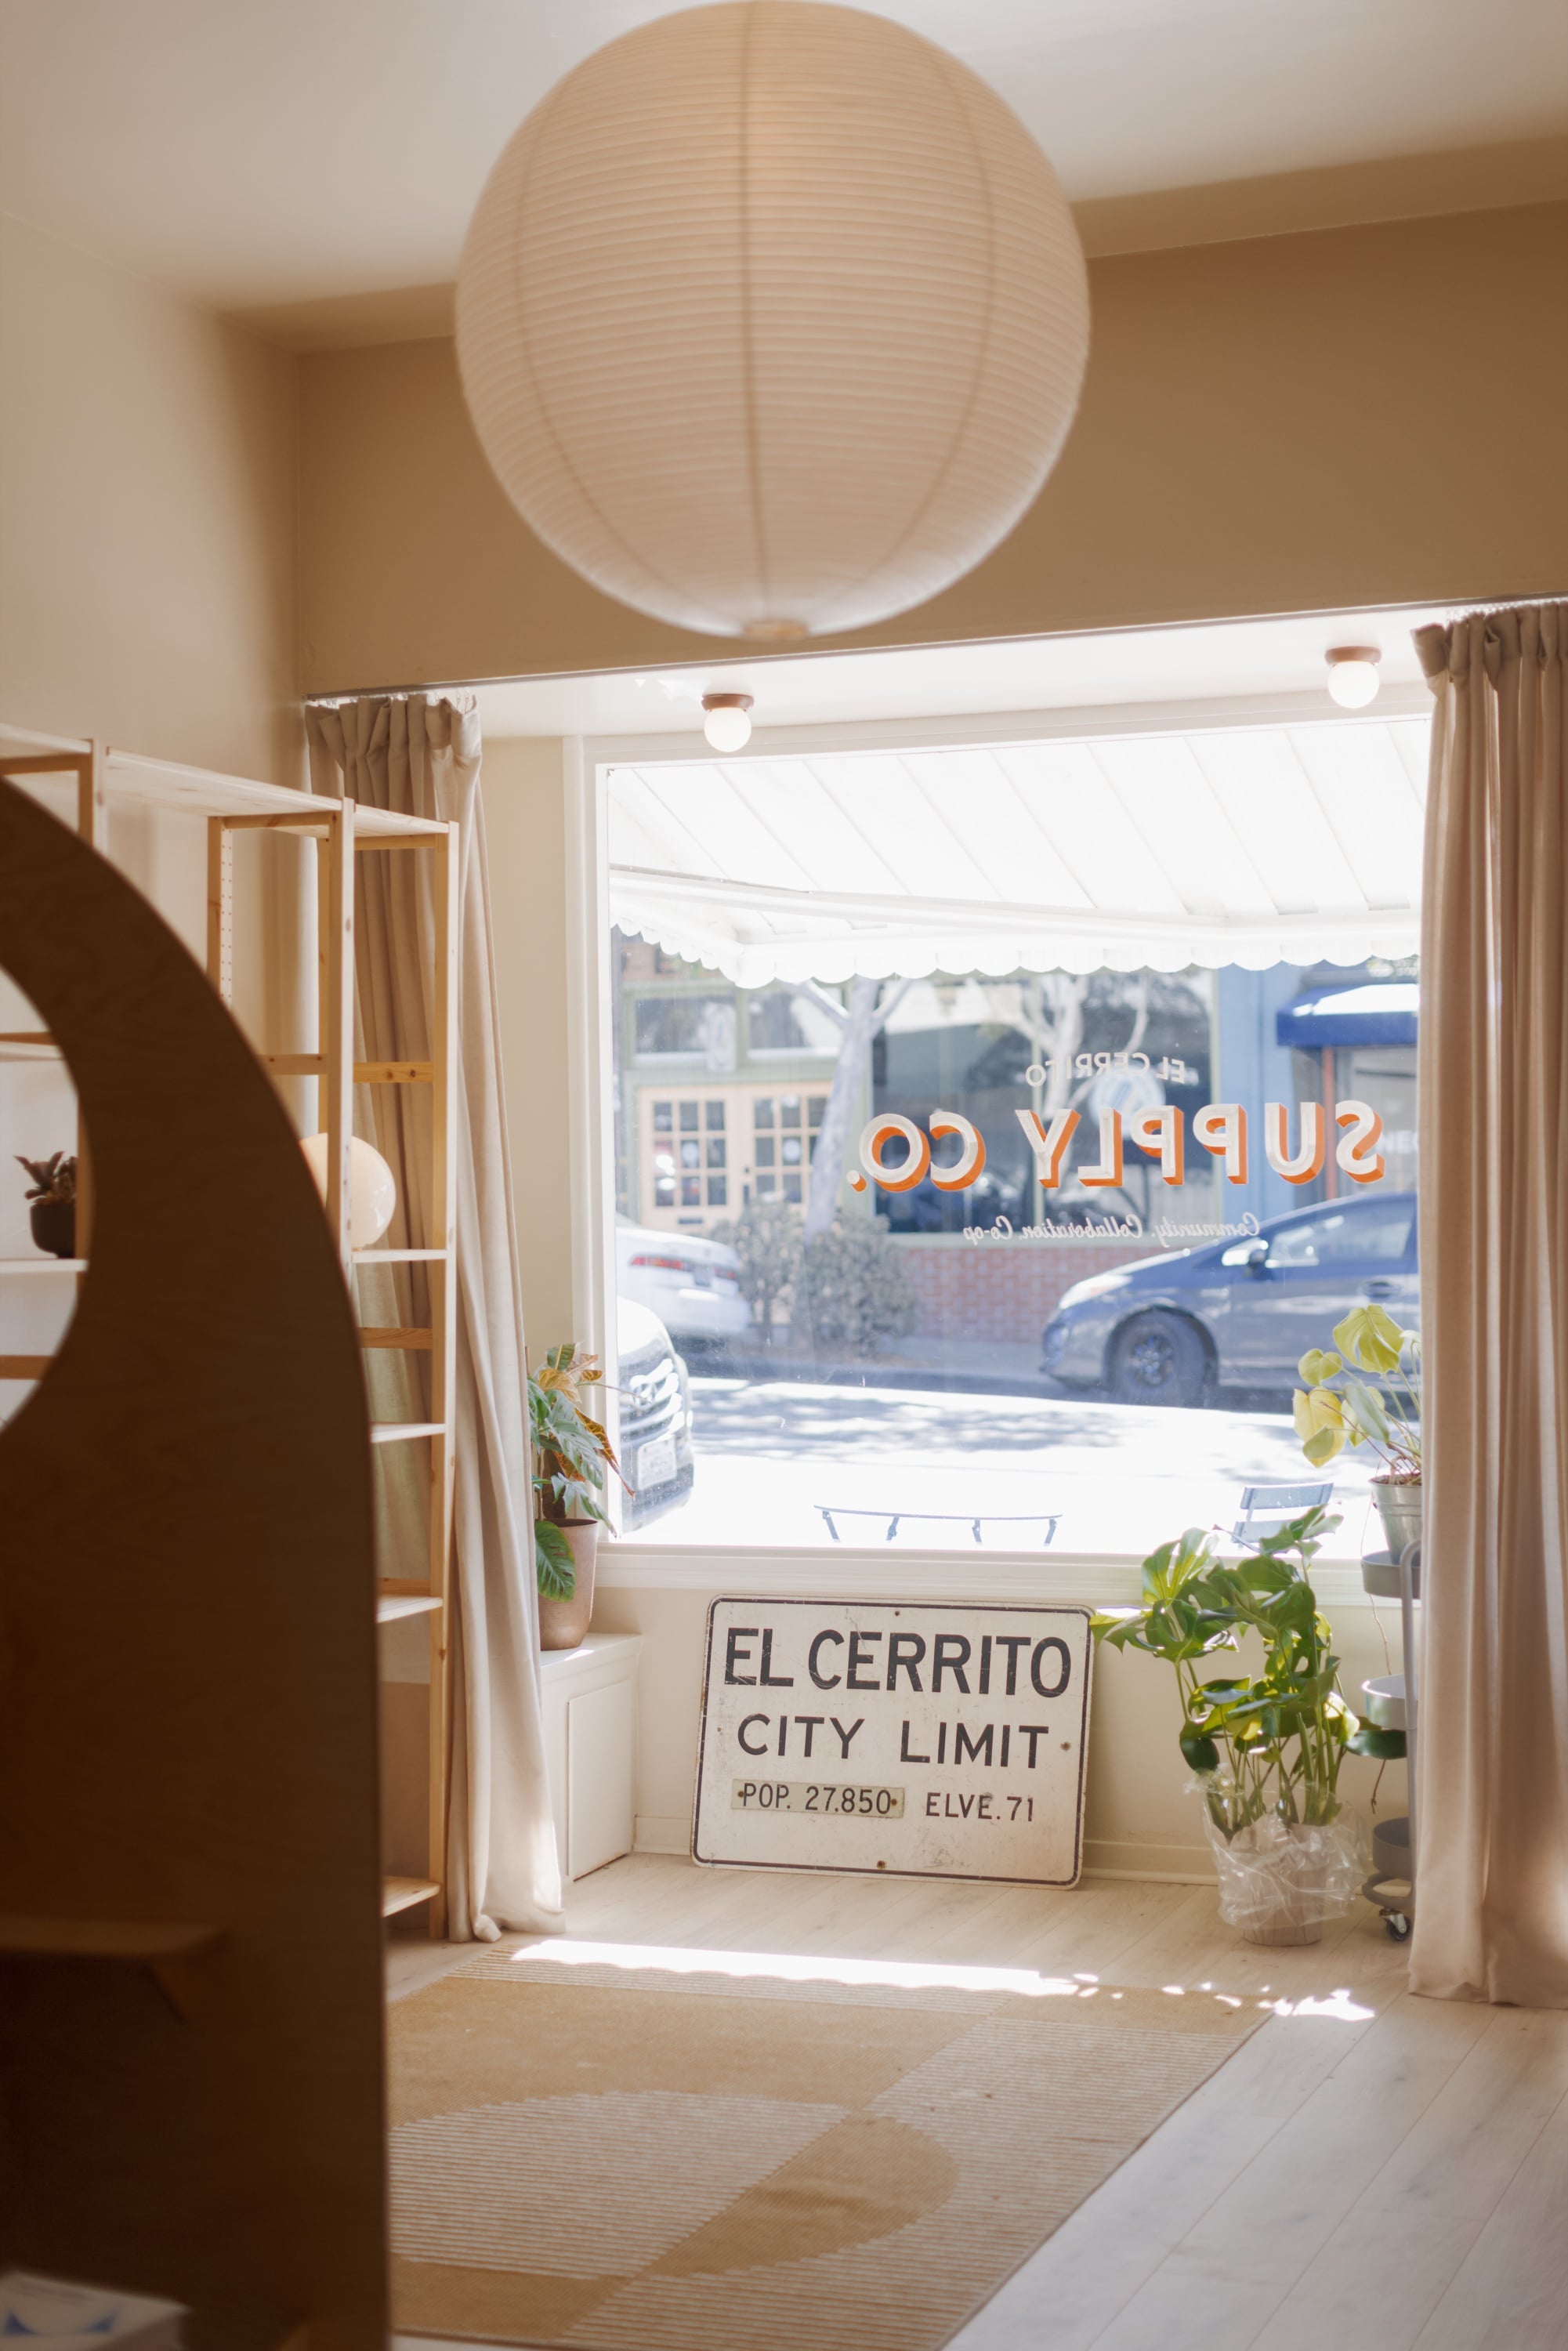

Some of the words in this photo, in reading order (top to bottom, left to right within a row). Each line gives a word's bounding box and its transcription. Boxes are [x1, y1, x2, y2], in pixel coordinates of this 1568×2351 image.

[723, 1627, 794, 1688] EL
[807, 1628, 1072, 1699] CERRITO
[737, 1713, 866, 1759] CITY
[900, 1719, 1049, 1770] LIMIT
[743, 1782, 791, 1809] POP.
